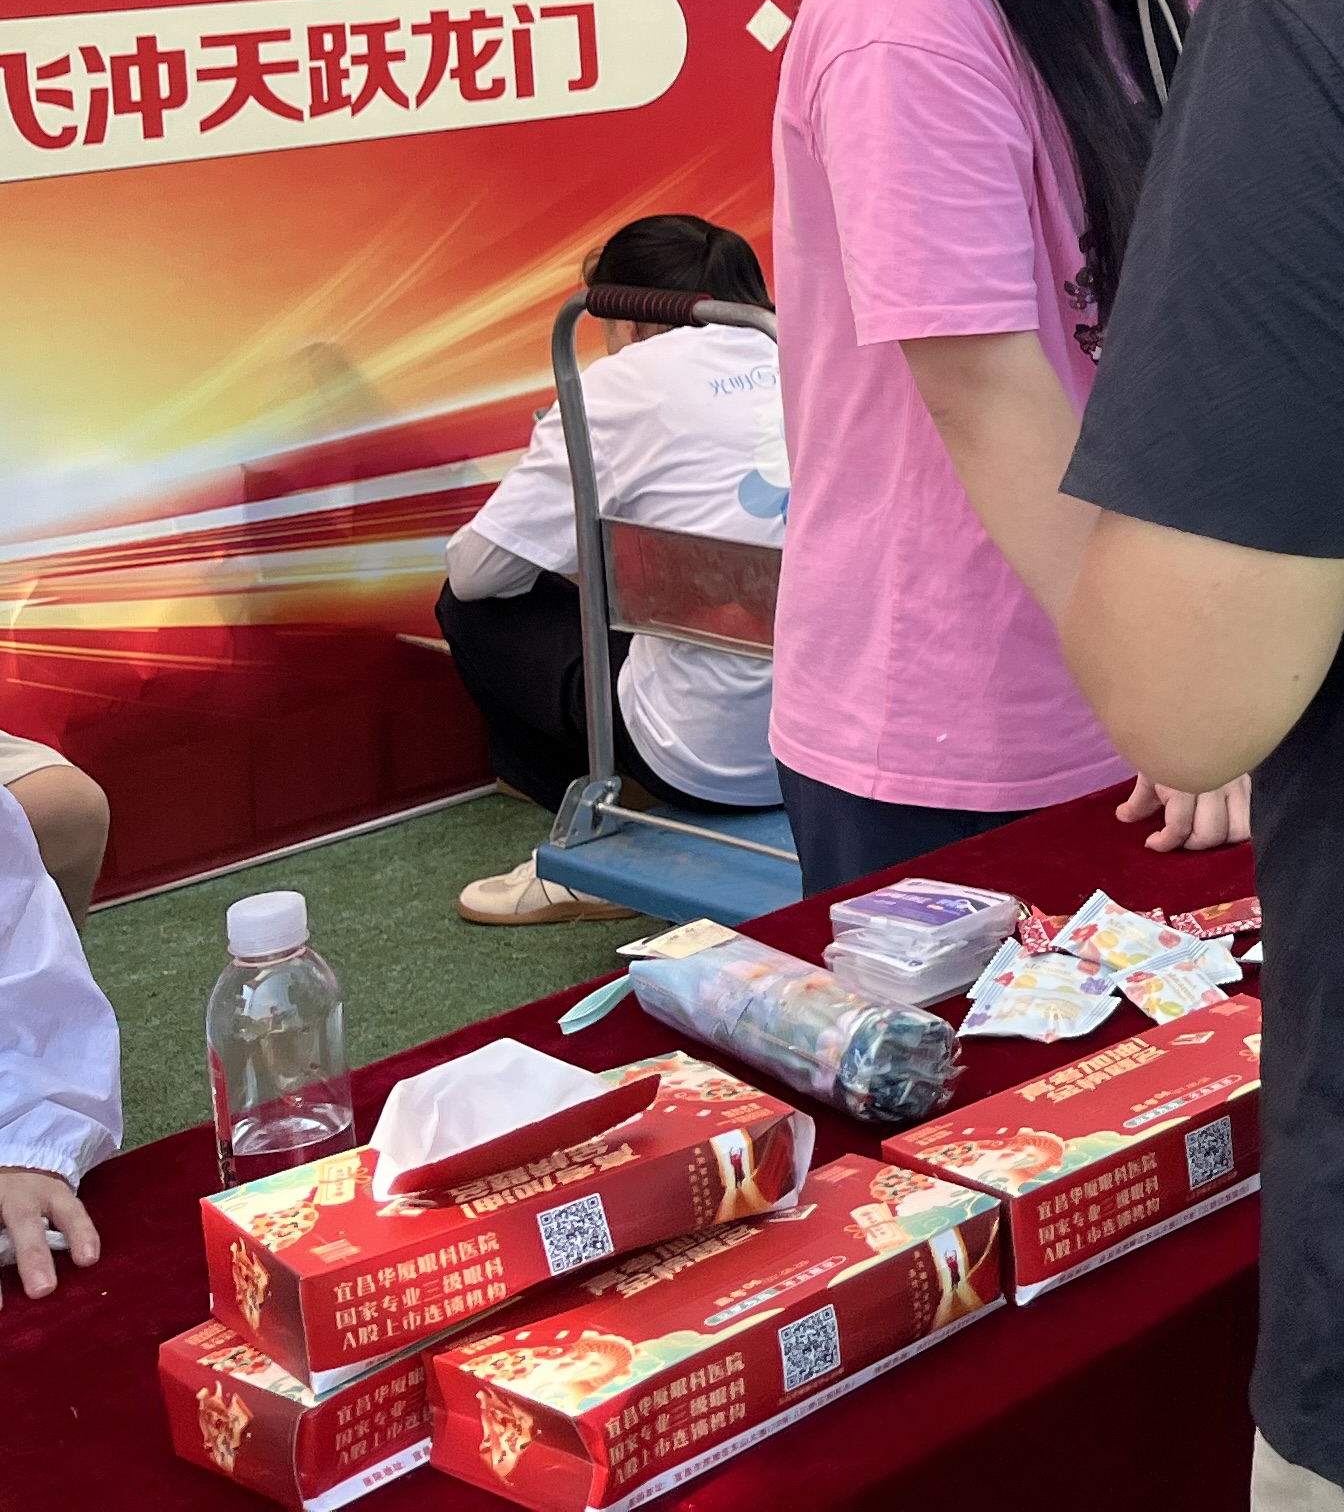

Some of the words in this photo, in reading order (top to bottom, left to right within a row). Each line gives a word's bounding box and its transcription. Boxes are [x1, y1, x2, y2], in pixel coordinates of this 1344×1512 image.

[335, 1257, 503, 1330] 国家专业三级眼科
[342, 1282, 507, 1351] A股上市连锁机构
